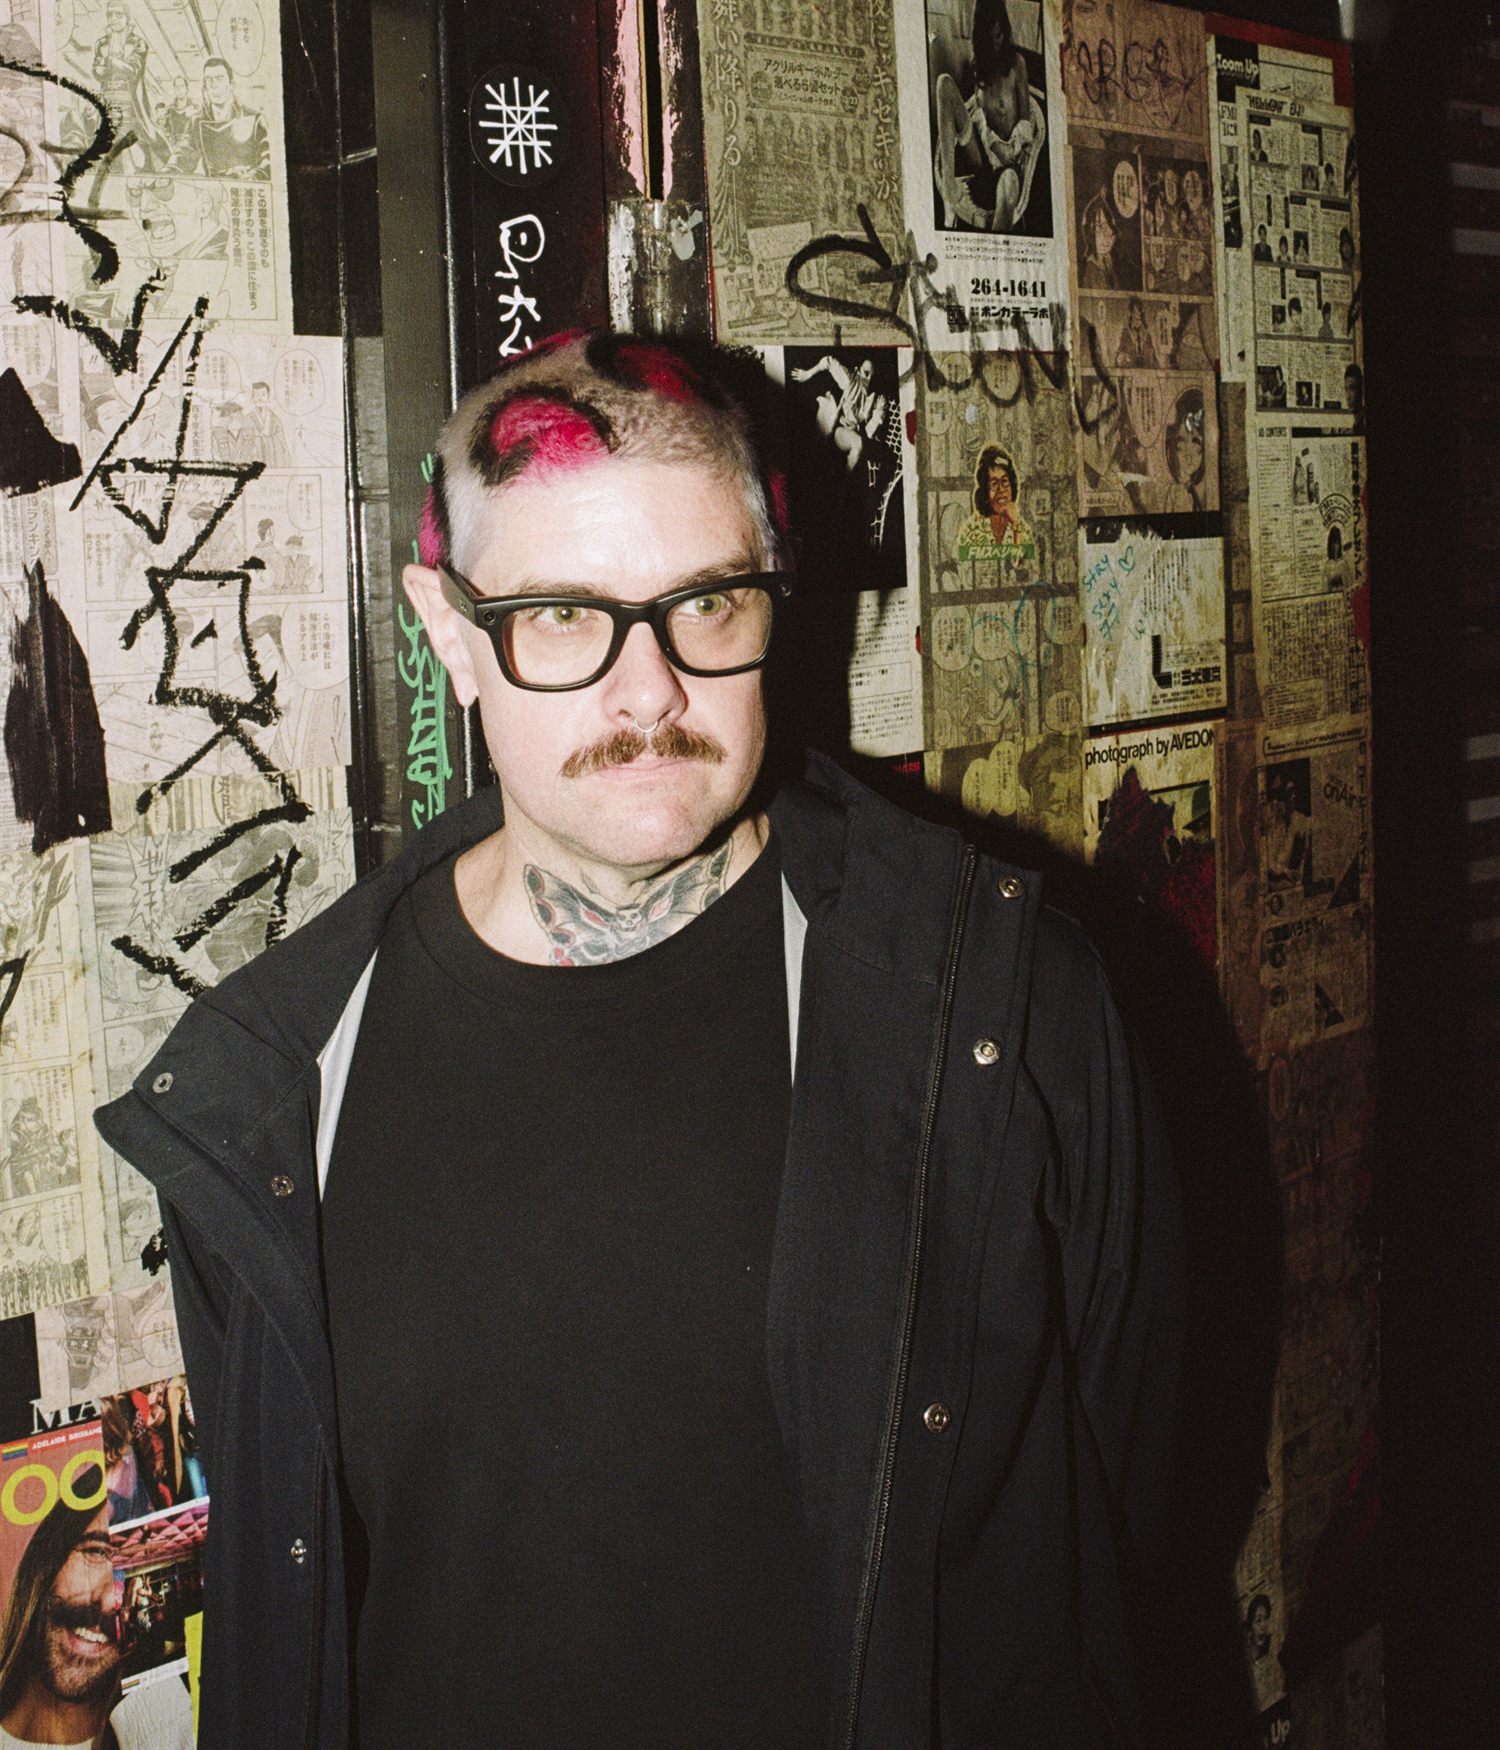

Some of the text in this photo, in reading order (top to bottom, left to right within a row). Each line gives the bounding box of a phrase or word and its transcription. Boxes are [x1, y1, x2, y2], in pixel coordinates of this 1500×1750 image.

[971, 278, 1046, 297] 264-1641
[1085, 741, 1154, 769] photograph
[1155, 739, 1170, 757] by
[32, 1435, 66, 1450] ADELAIDE
